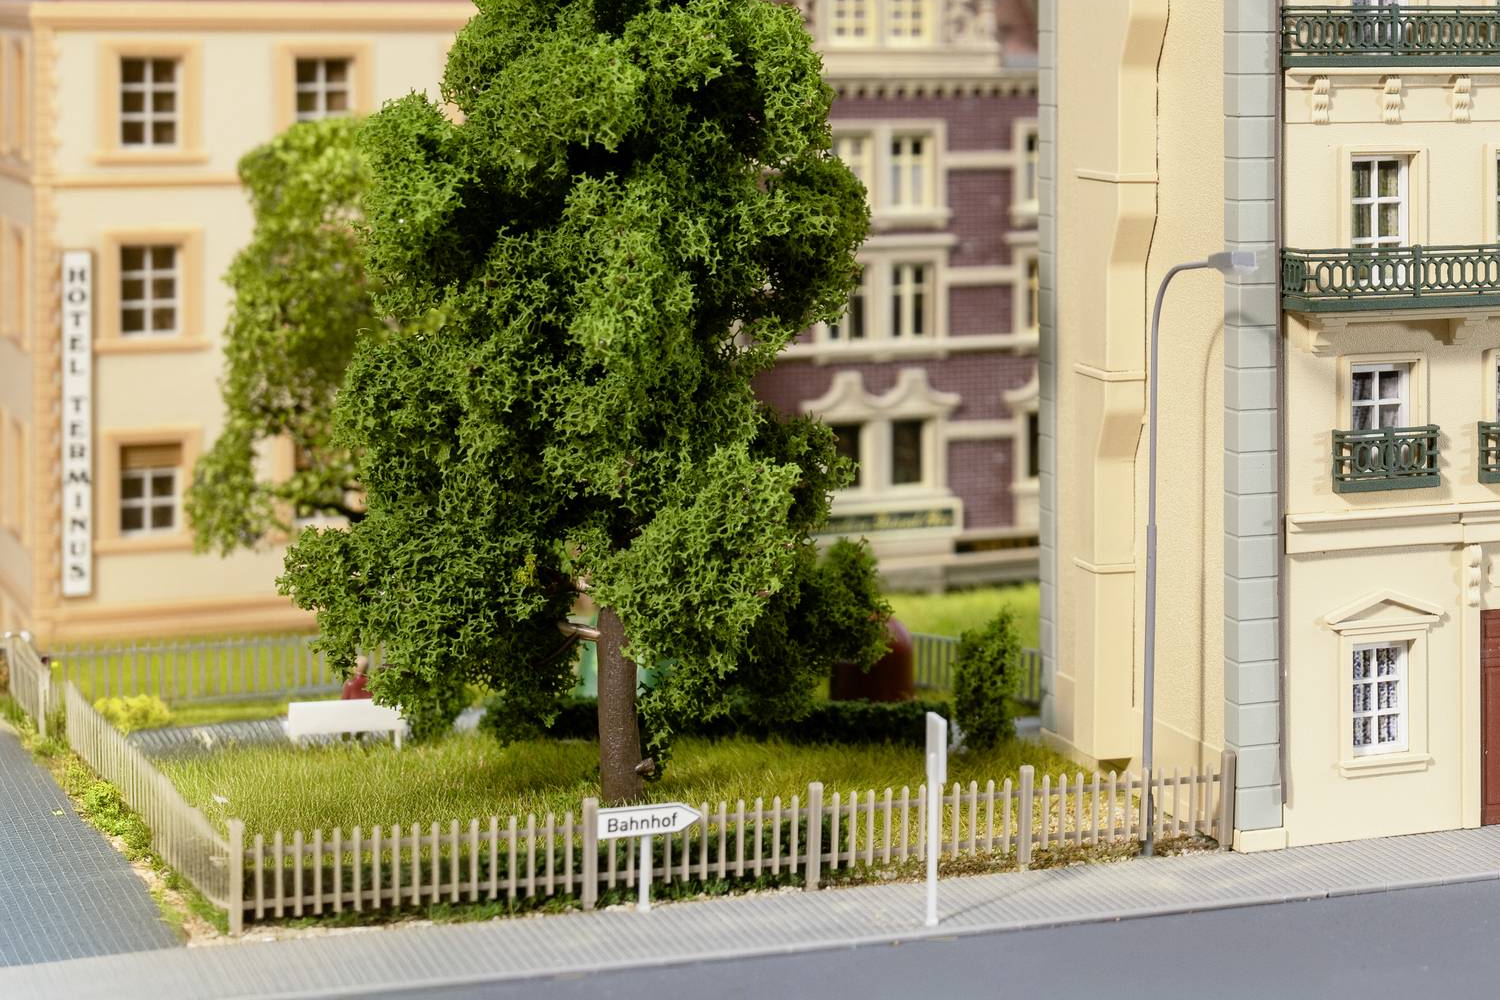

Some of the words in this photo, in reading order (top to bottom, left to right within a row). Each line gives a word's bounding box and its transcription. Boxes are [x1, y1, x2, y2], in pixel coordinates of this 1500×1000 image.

[66, 266, 87, 375] HOTEL
[65, 395, 92, 581] TERMINUS
[607, 812, 678, 833] Bahnhof
